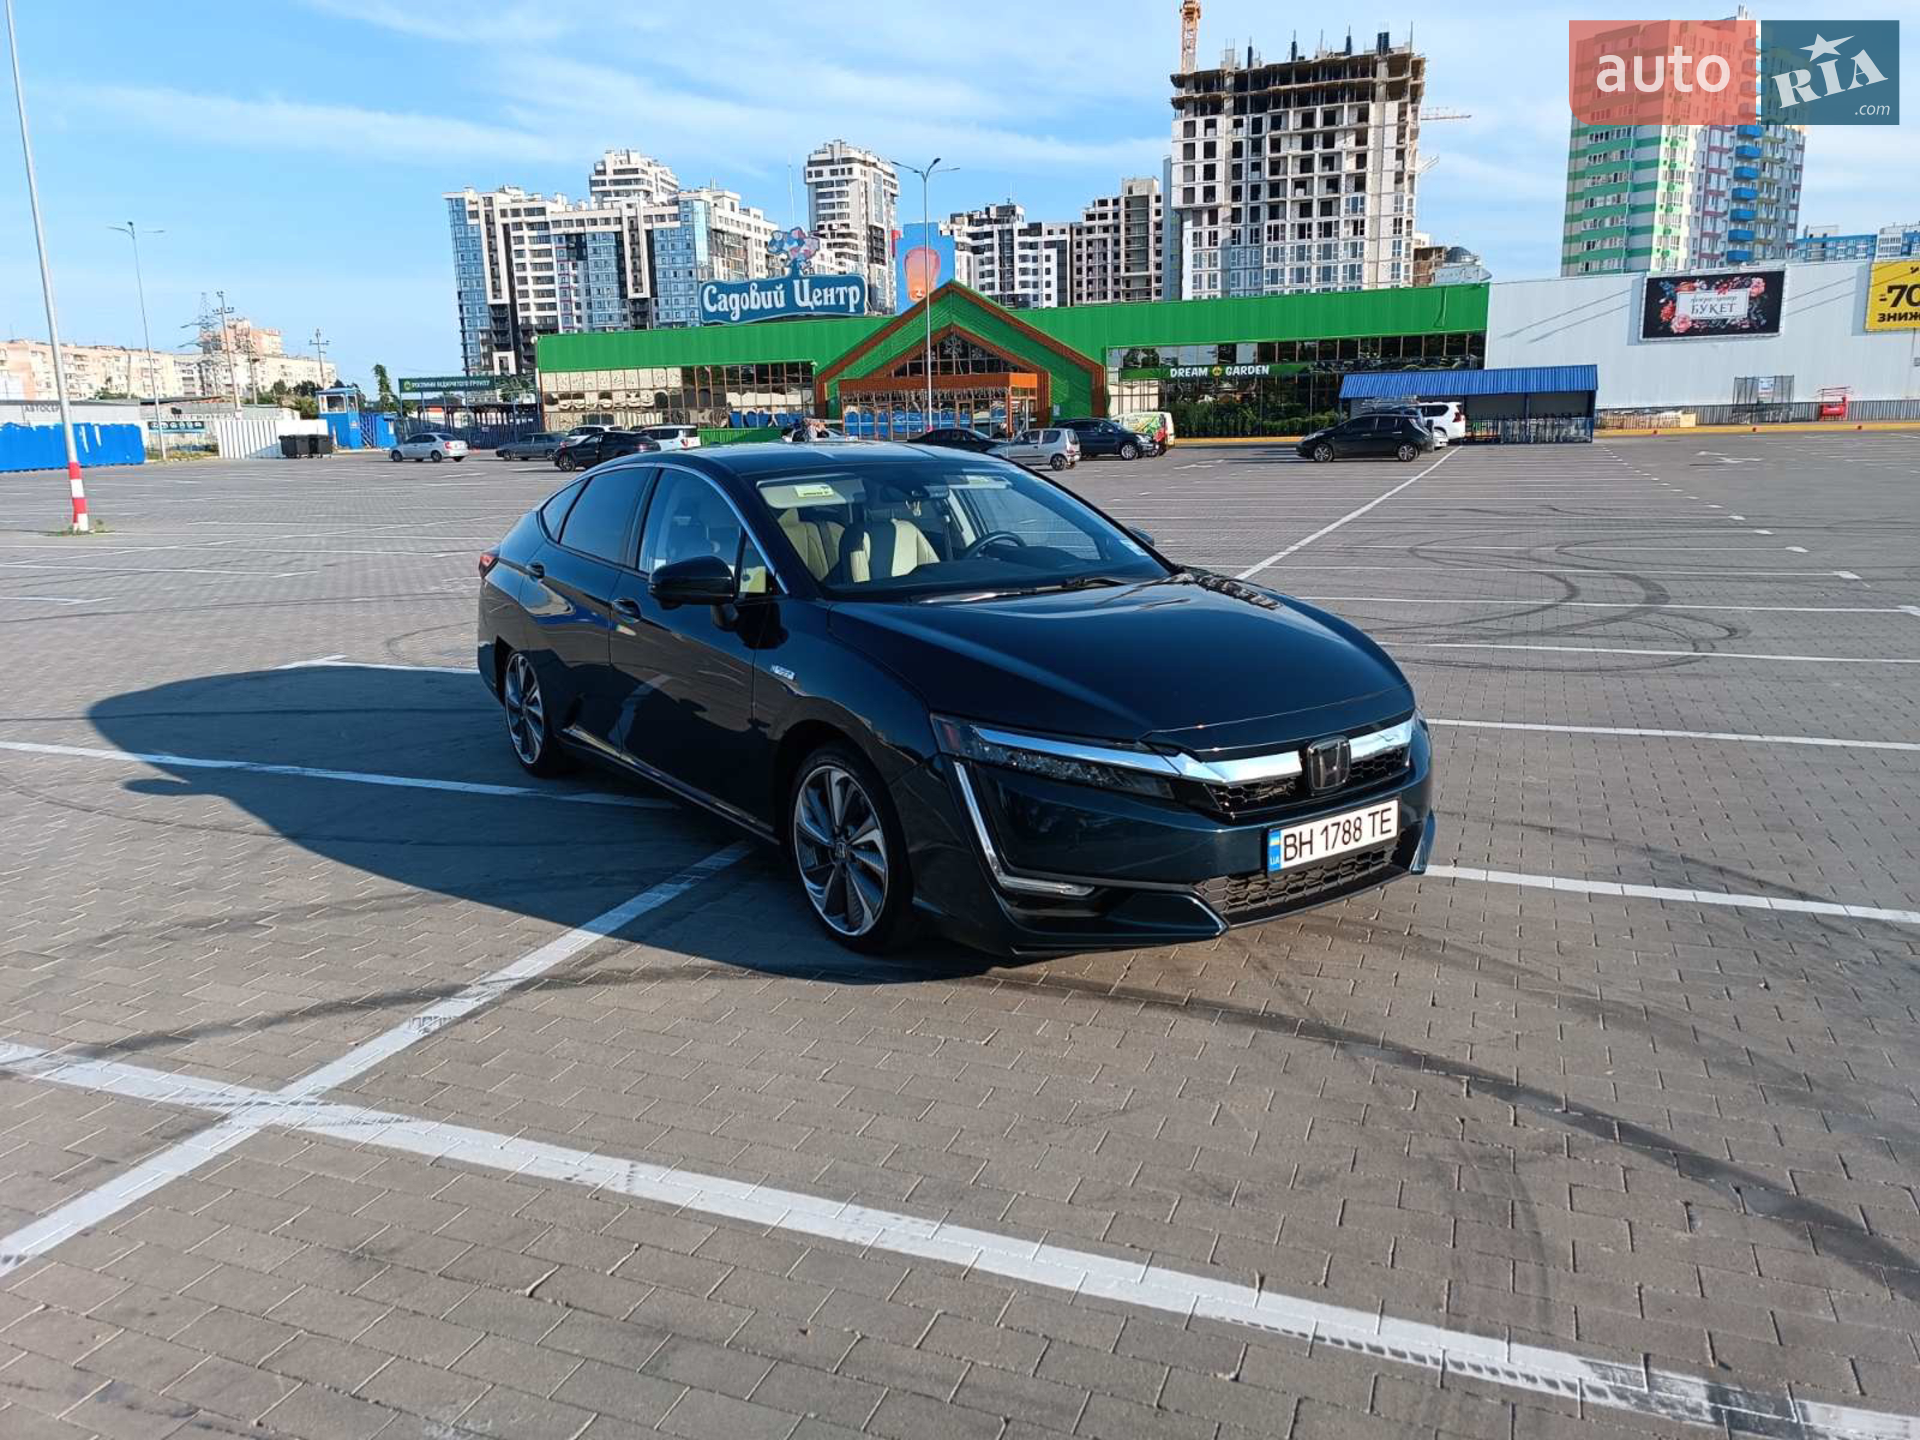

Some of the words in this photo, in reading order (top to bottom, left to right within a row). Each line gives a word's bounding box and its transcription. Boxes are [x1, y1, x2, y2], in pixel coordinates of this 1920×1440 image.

[702, 282, 786, 321] Садовий
[792, 279, 861, 312] Центр
[1691, 302, 1737, 315] БУКЕТ
[1170, 367, 1208, 378] DREAM
[1225, 365, 1270, 376] GARDEN
[1284, 828, 1314, 862] BH
[1320, 817, 1362, 851] 1788
[1368, 807, 1392, 838] TE
